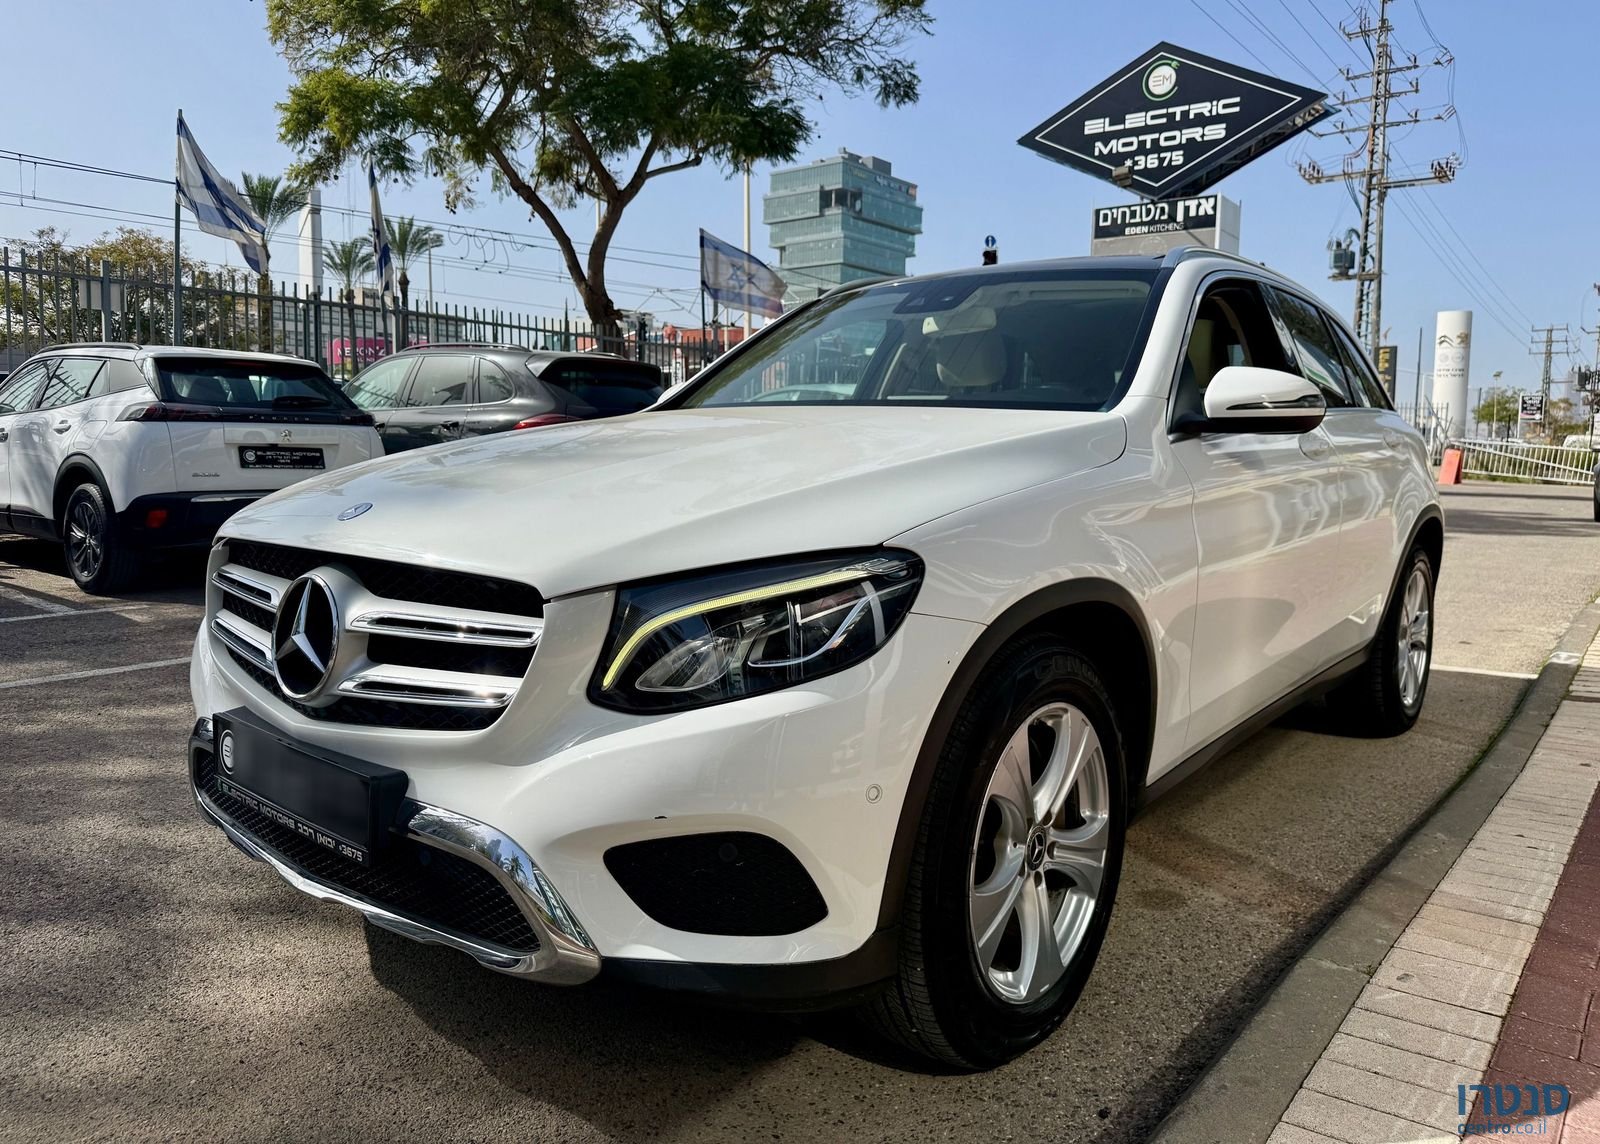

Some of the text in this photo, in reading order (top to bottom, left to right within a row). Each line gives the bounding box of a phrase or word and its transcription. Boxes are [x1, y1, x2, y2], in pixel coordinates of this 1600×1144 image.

[1094, 123, 1227, 156] MOTORS
[1098, 196, 1216, 227] אדן מטבחים
[1125, 221, 1184, 235] EDEN KITCHENS
